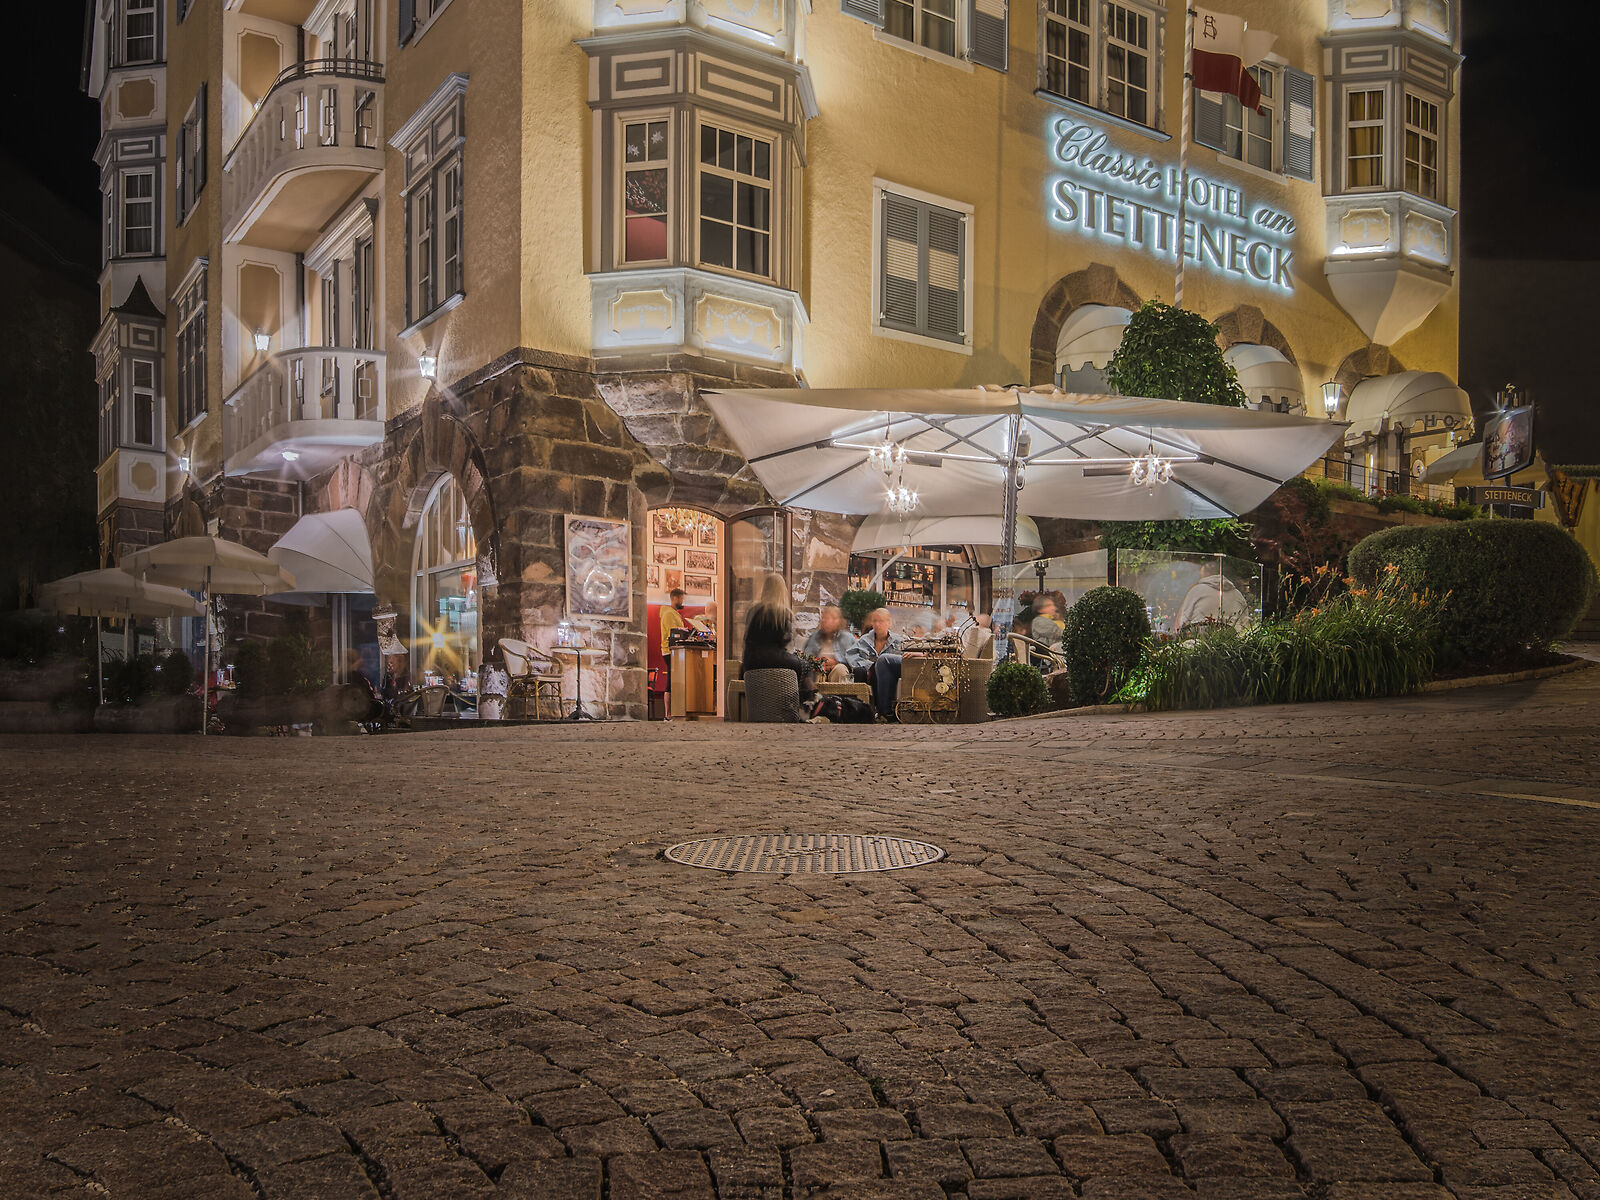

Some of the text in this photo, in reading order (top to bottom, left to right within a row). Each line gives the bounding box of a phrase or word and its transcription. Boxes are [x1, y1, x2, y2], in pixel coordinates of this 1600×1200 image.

[1053, 118, 1297, 235] Classic HOTEL am
[1052, 179, 1295, 290] STETTENECK
[1484, 490, 1532, 502] STETTENECK
